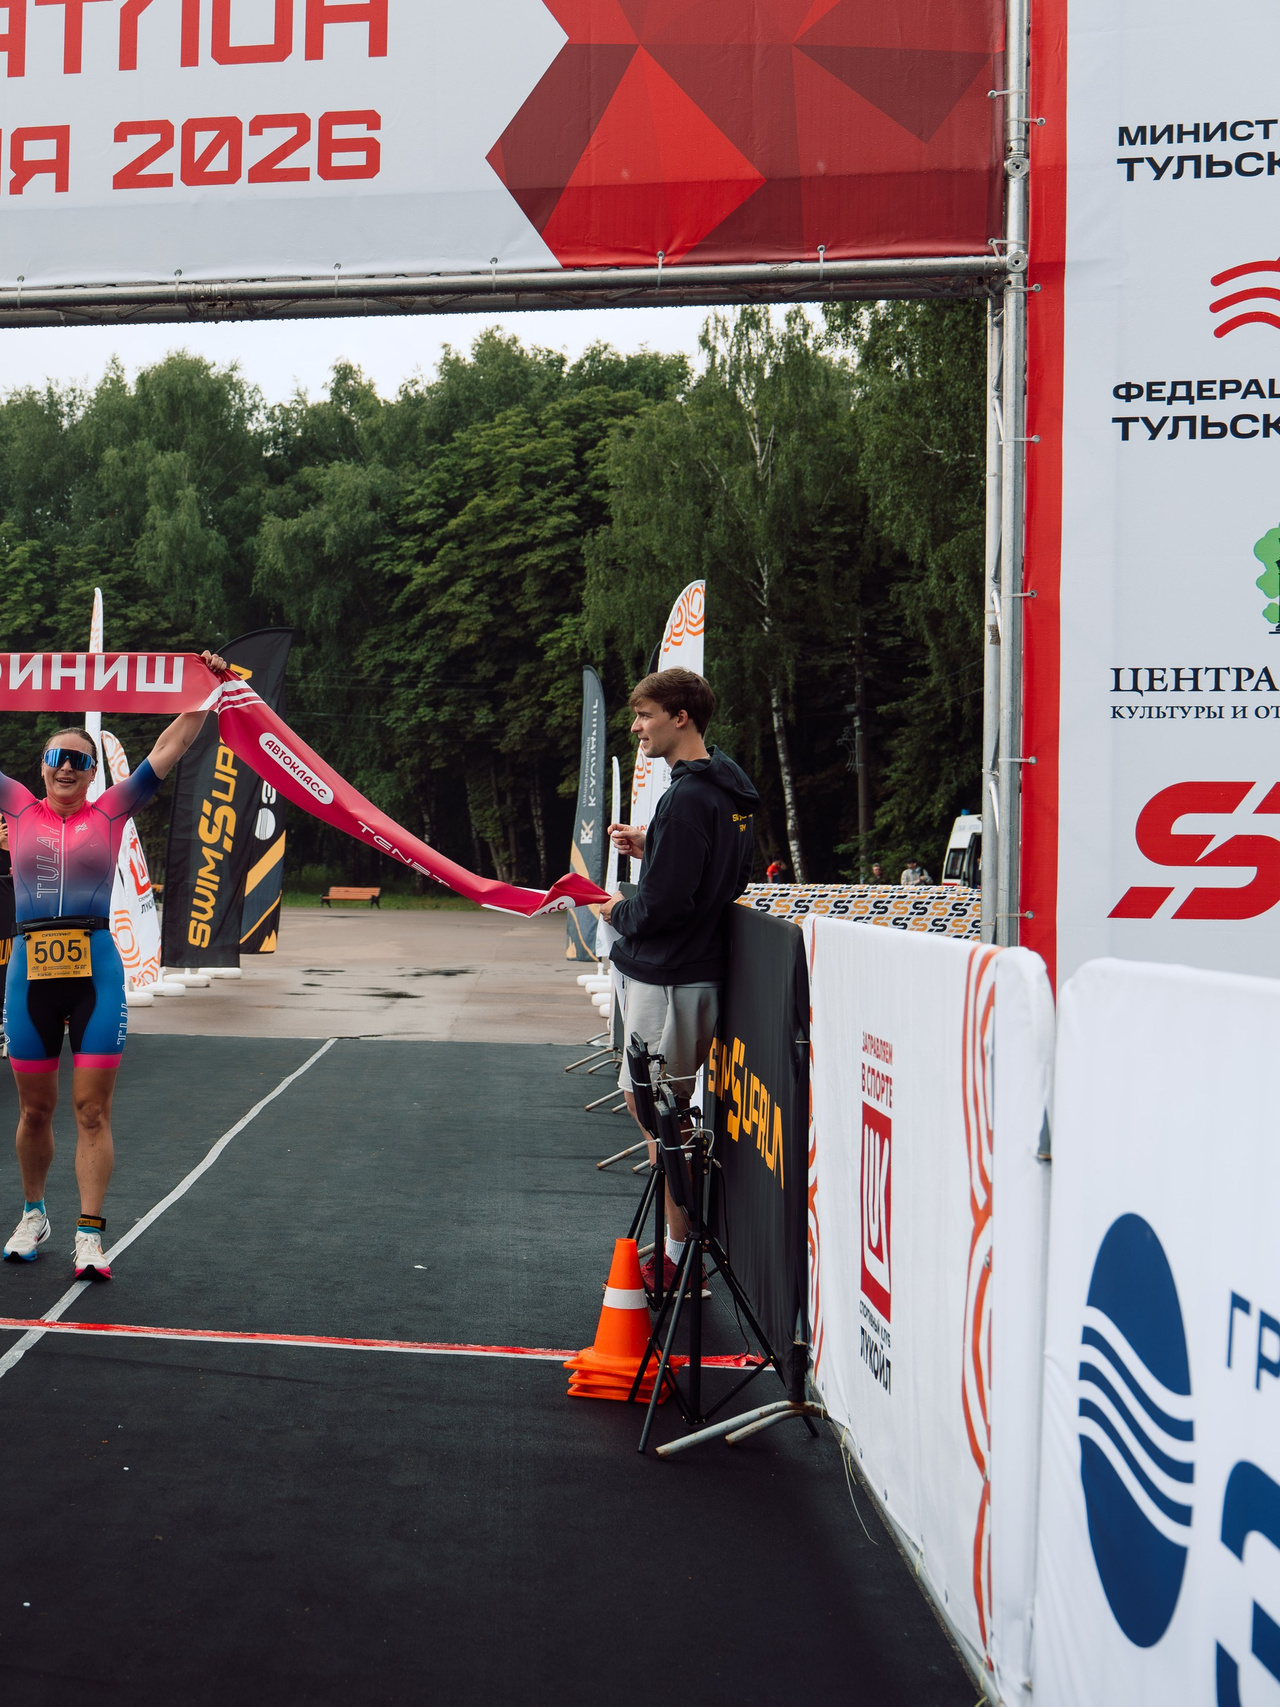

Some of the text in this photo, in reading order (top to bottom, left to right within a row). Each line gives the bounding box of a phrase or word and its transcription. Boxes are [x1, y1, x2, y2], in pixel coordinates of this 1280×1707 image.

[113, 110, 382, 190] 2026
[1110, 665, 1280, 697] ЦЕНТРА
[1110, 705, 1224, 719] КУЛЬТУРЫ
[1231, 705, 1249, 719] И
[264, 739, 327, 799] АВТОКЛАСС
[36, 836, 60, 899] TULA
[34, 939, 82, 964] 505
[867, 1065, 892, 1109] СПОРТЕ
[860, 1324, 891, 1395] ЛУКОЙЛ
